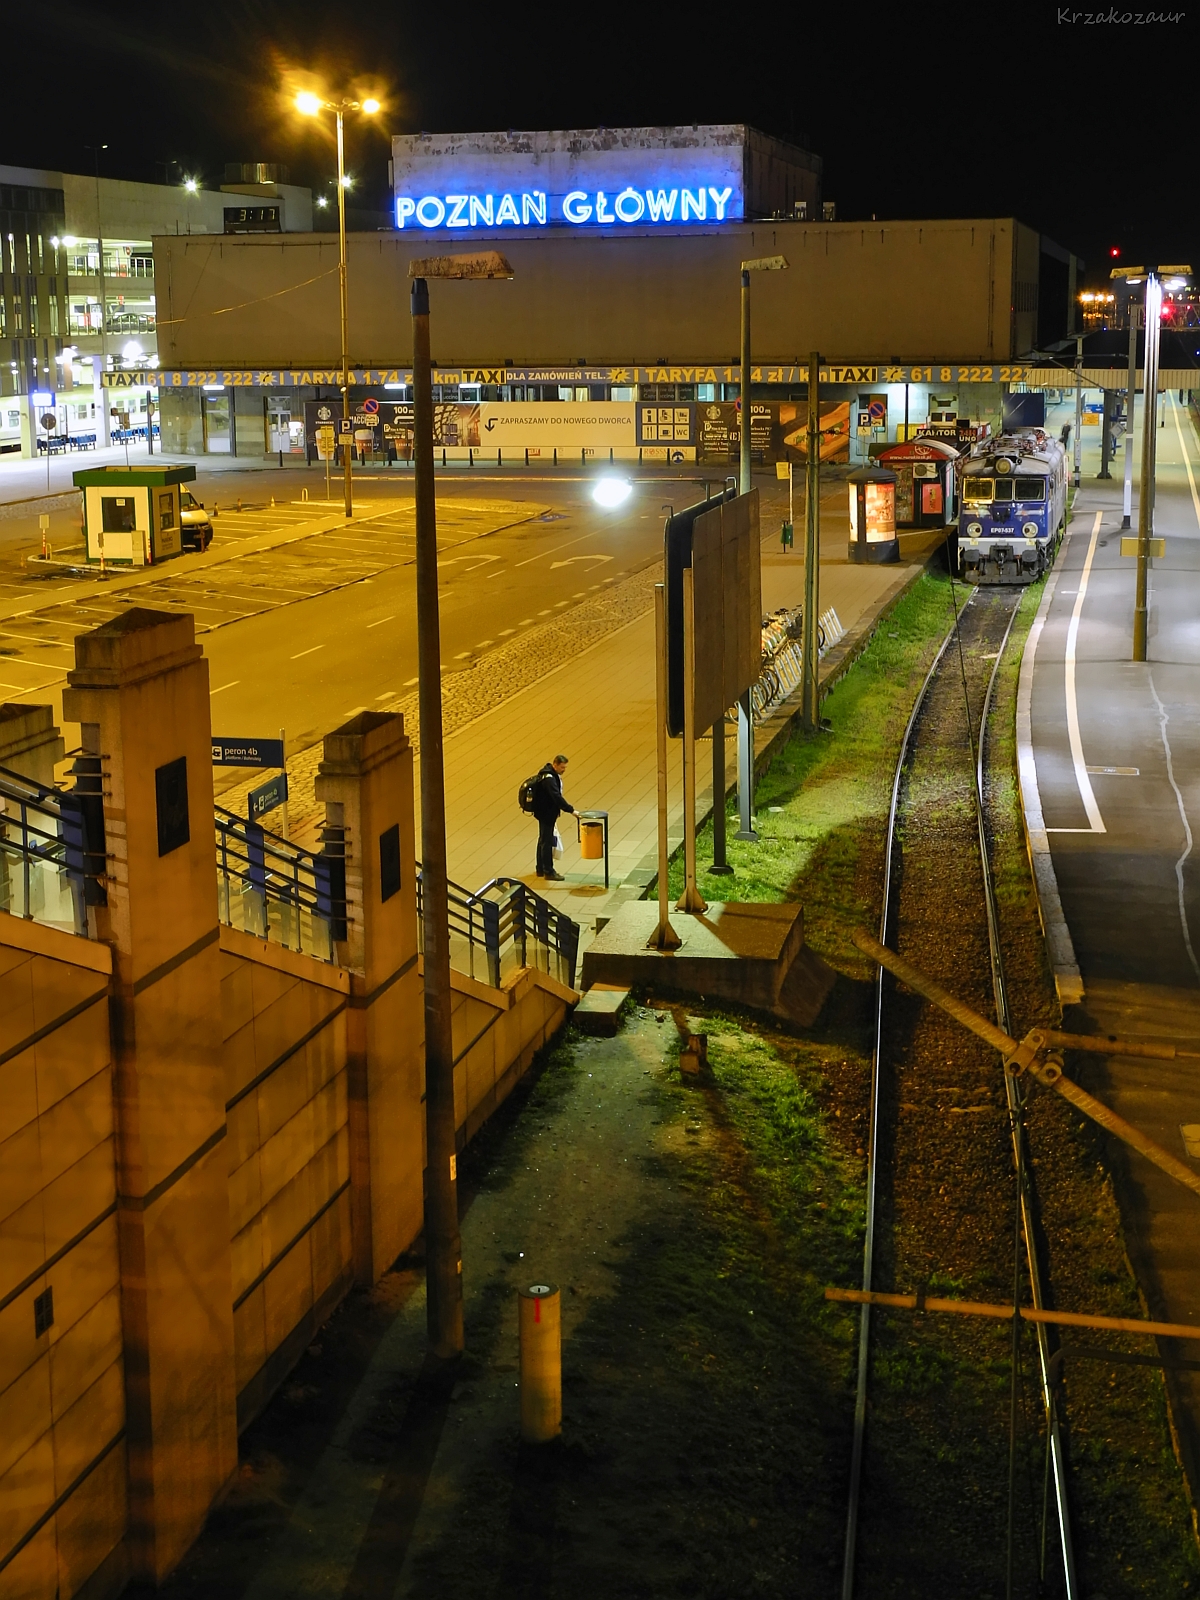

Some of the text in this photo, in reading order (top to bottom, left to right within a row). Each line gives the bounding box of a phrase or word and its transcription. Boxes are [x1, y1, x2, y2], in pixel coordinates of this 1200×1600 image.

[240, 208, 275, 221] 3:17
[397, 187, 732, 229] POZNAŃ GŁÓWNY
[105, 373, 144, 386] TAXI
[147, 372, 253, 386] 61 8 222 222
[363, 371, 399, 385] 1.74
[433, 371, 459, 384] km
[463, 371, 505, 383] TAXI
[528, 370, 582, 380] ZAMÓWIEŃ
[584, 371, 606, 380] TEL.
[645, 368, 717, 382] TARYFA
[723, 368, 762, 382] 1.4
[768, 368, 783, 382] zł
[831, 368, 877, 382] TAXI
[911, 367, 932, 382] 61
[940, 367, 952, 382] 8
[958, 367, 993, 382] 222
[393, 406, 408, 414] 100
[341, 420, 350, 433] P
[500, 417, 632, 425] ZAPRASZAMY DO NOWEGO DWORCA
[861, 414, 869, 426] P
[224, 747, 258, 756] peron 4b
